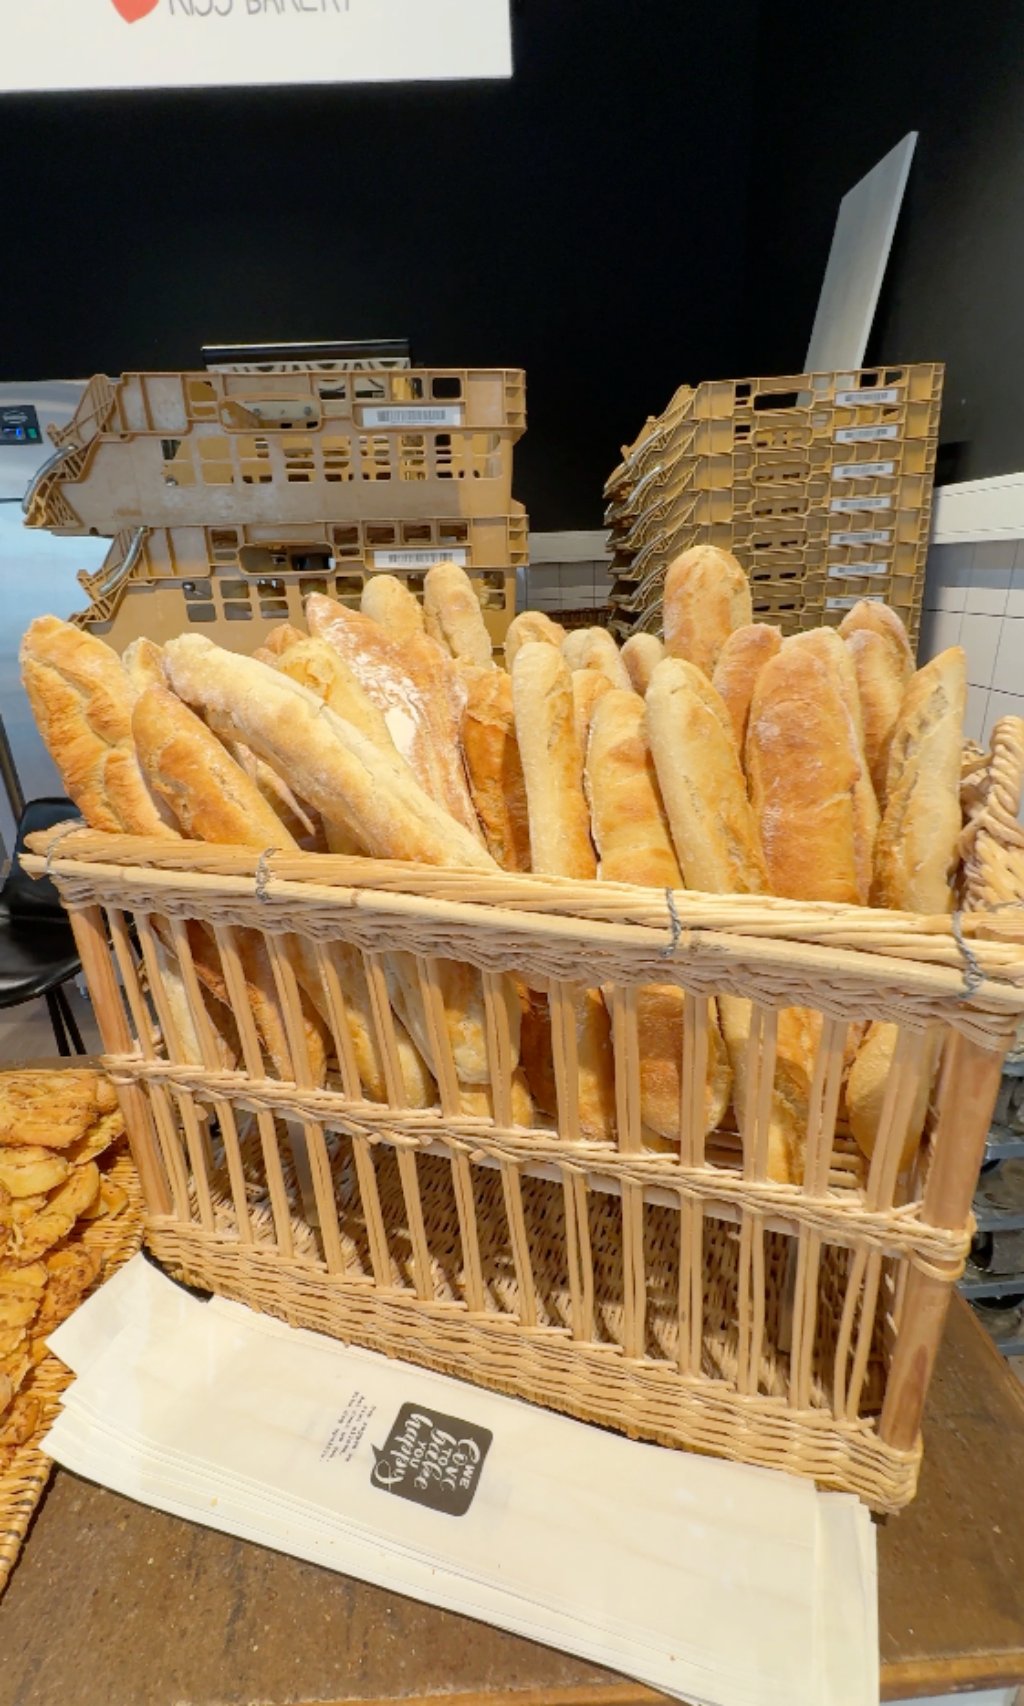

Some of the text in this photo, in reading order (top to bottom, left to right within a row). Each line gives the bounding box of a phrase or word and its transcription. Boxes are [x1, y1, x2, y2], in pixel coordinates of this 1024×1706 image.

[374, 1413, 434, 1492] happy
[409, 1441, 427, 1469] YOU
[437, 1448, 453, 1466] TO
[459, 1464, 476, 1489] WE
